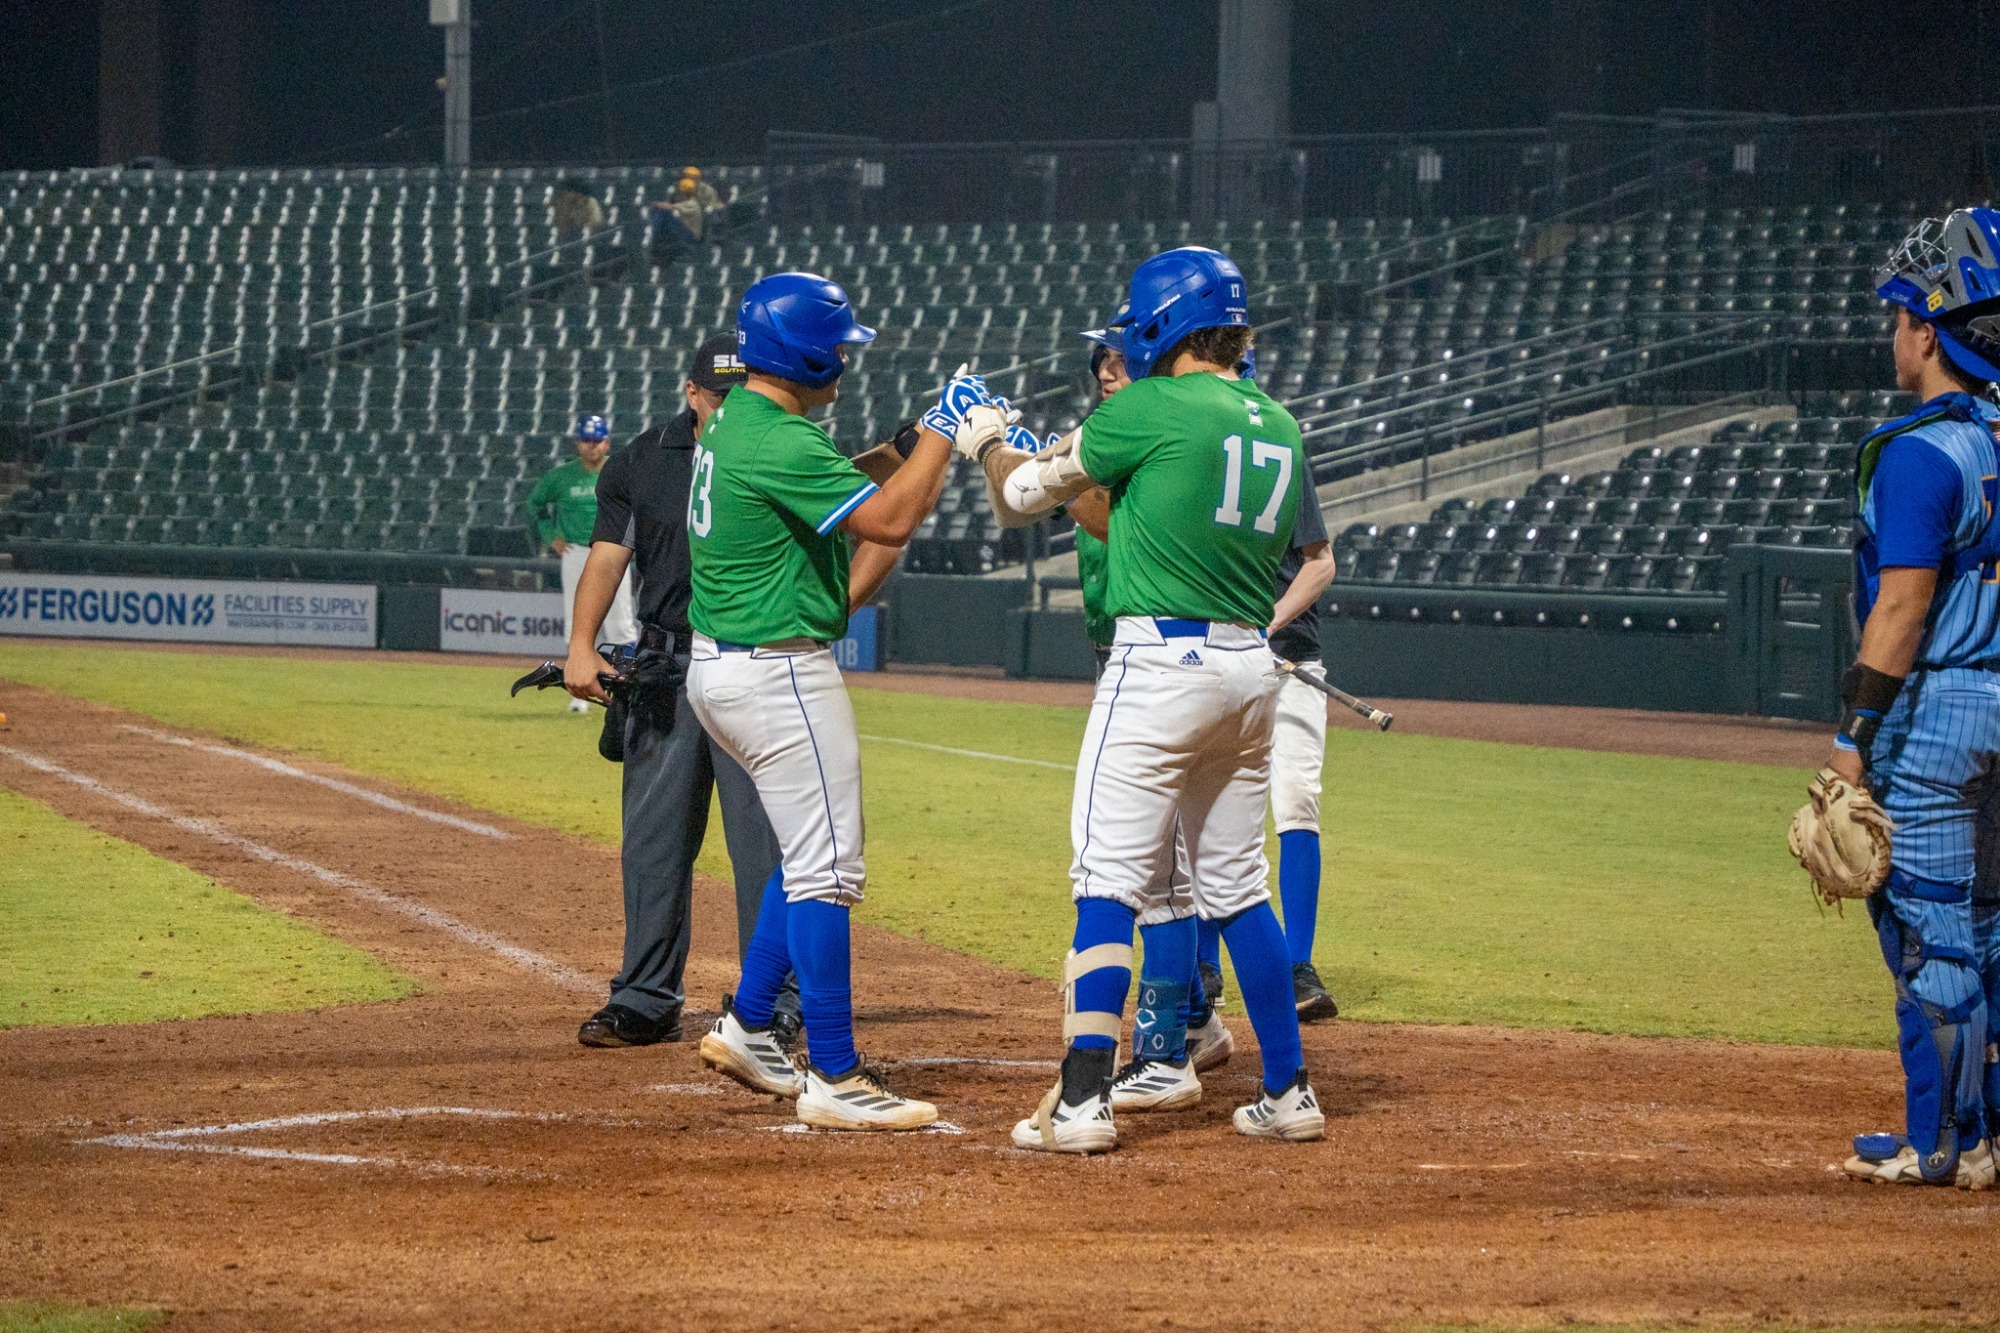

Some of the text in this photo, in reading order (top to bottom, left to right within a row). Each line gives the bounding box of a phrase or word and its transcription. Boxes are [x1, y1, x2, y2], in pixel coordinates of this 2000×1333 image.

[1231, 284, 1240, 298] 17
[1215, 434, 1293, 534] 17
[22, 587, 367, 626] FERGUSON FACILITIES SUPPLY
[444, 608, 516, 635] iconic
[1179, 659, 1204, 667] adidas
